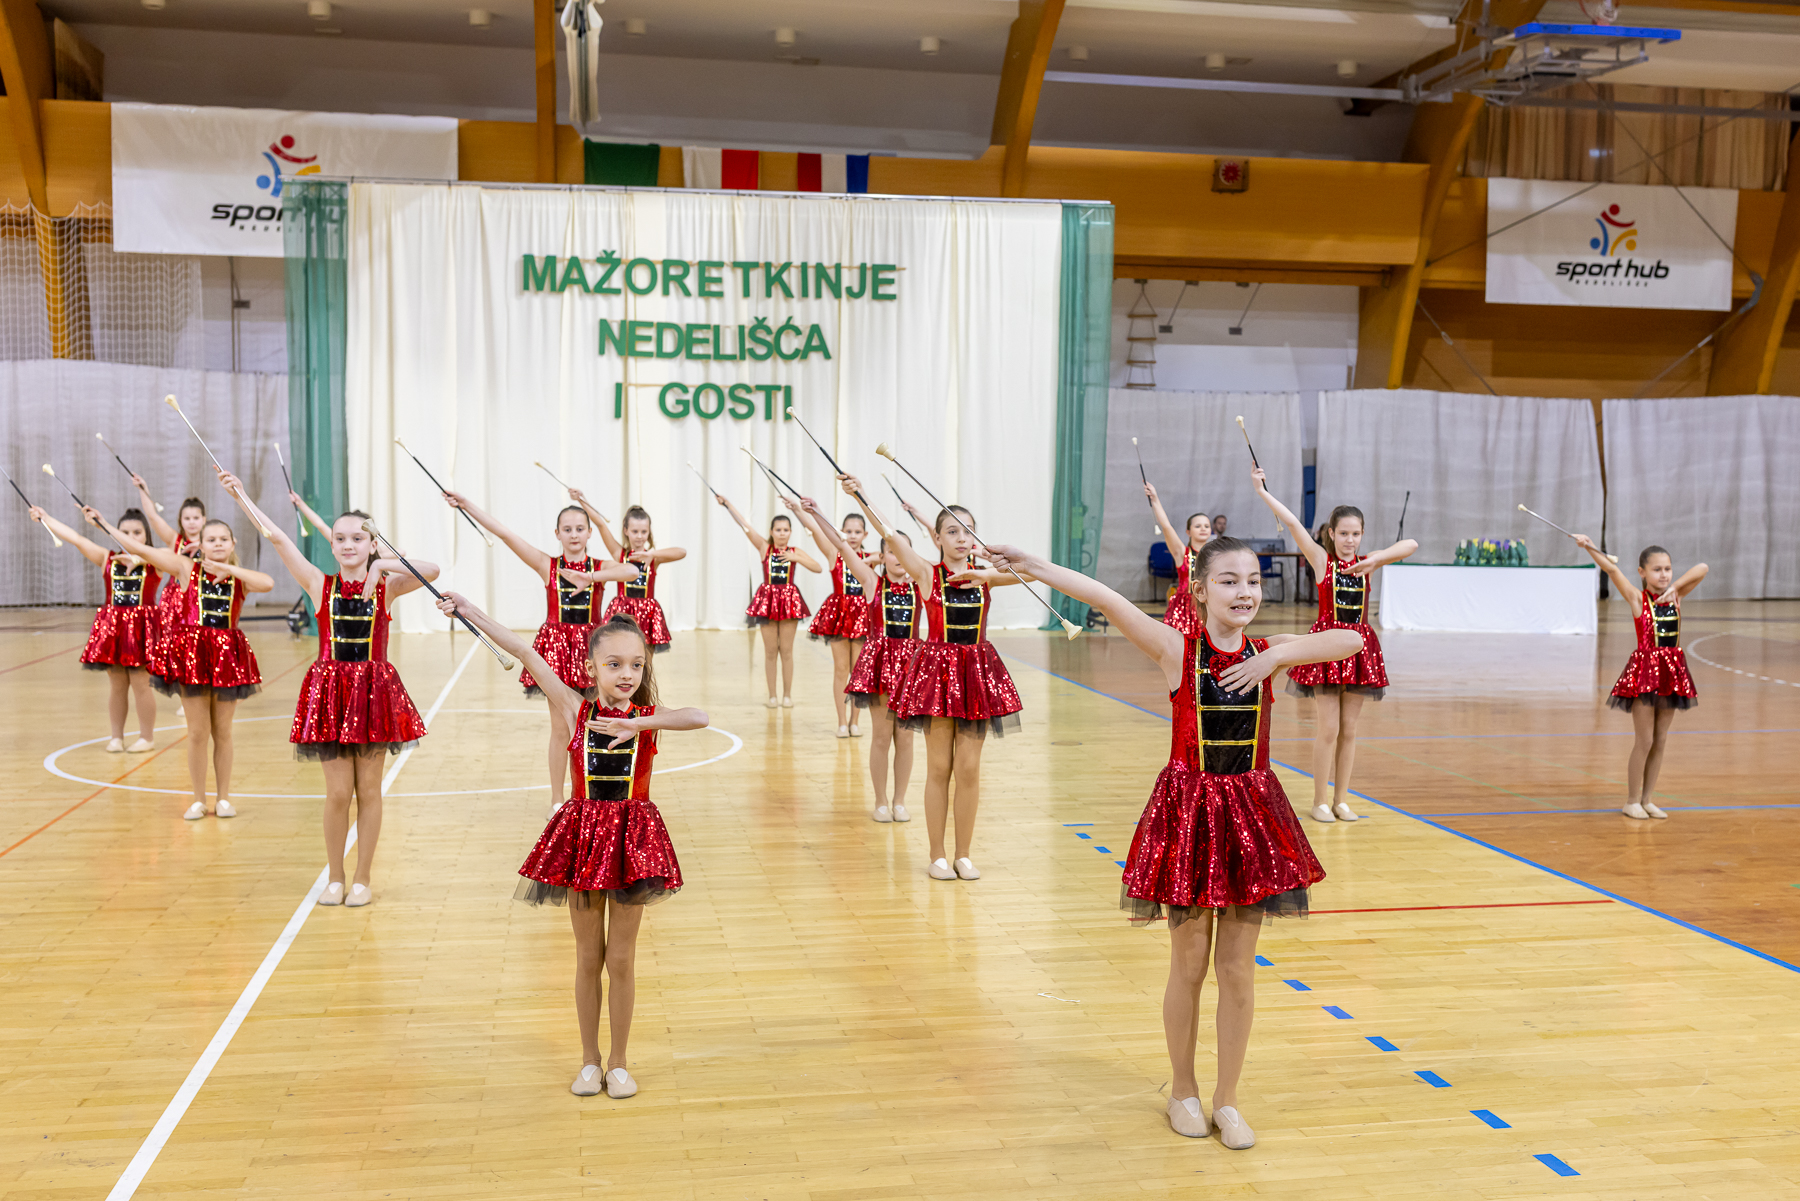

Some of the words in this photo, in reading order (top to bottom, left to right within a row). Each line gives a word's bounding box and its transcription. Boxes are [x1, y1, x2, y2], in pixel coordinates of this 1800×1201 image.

[522, 250, 896, 299] MAŽORETKINJE
[1556, 258, 1622, 281] sport
[1624, 258, 1670, 279] hub
[599, 317, 831, 360] NEDELIŠĆA
[615, 383, 622, 418] I
[659, 383, 791, 420] GOSTI
